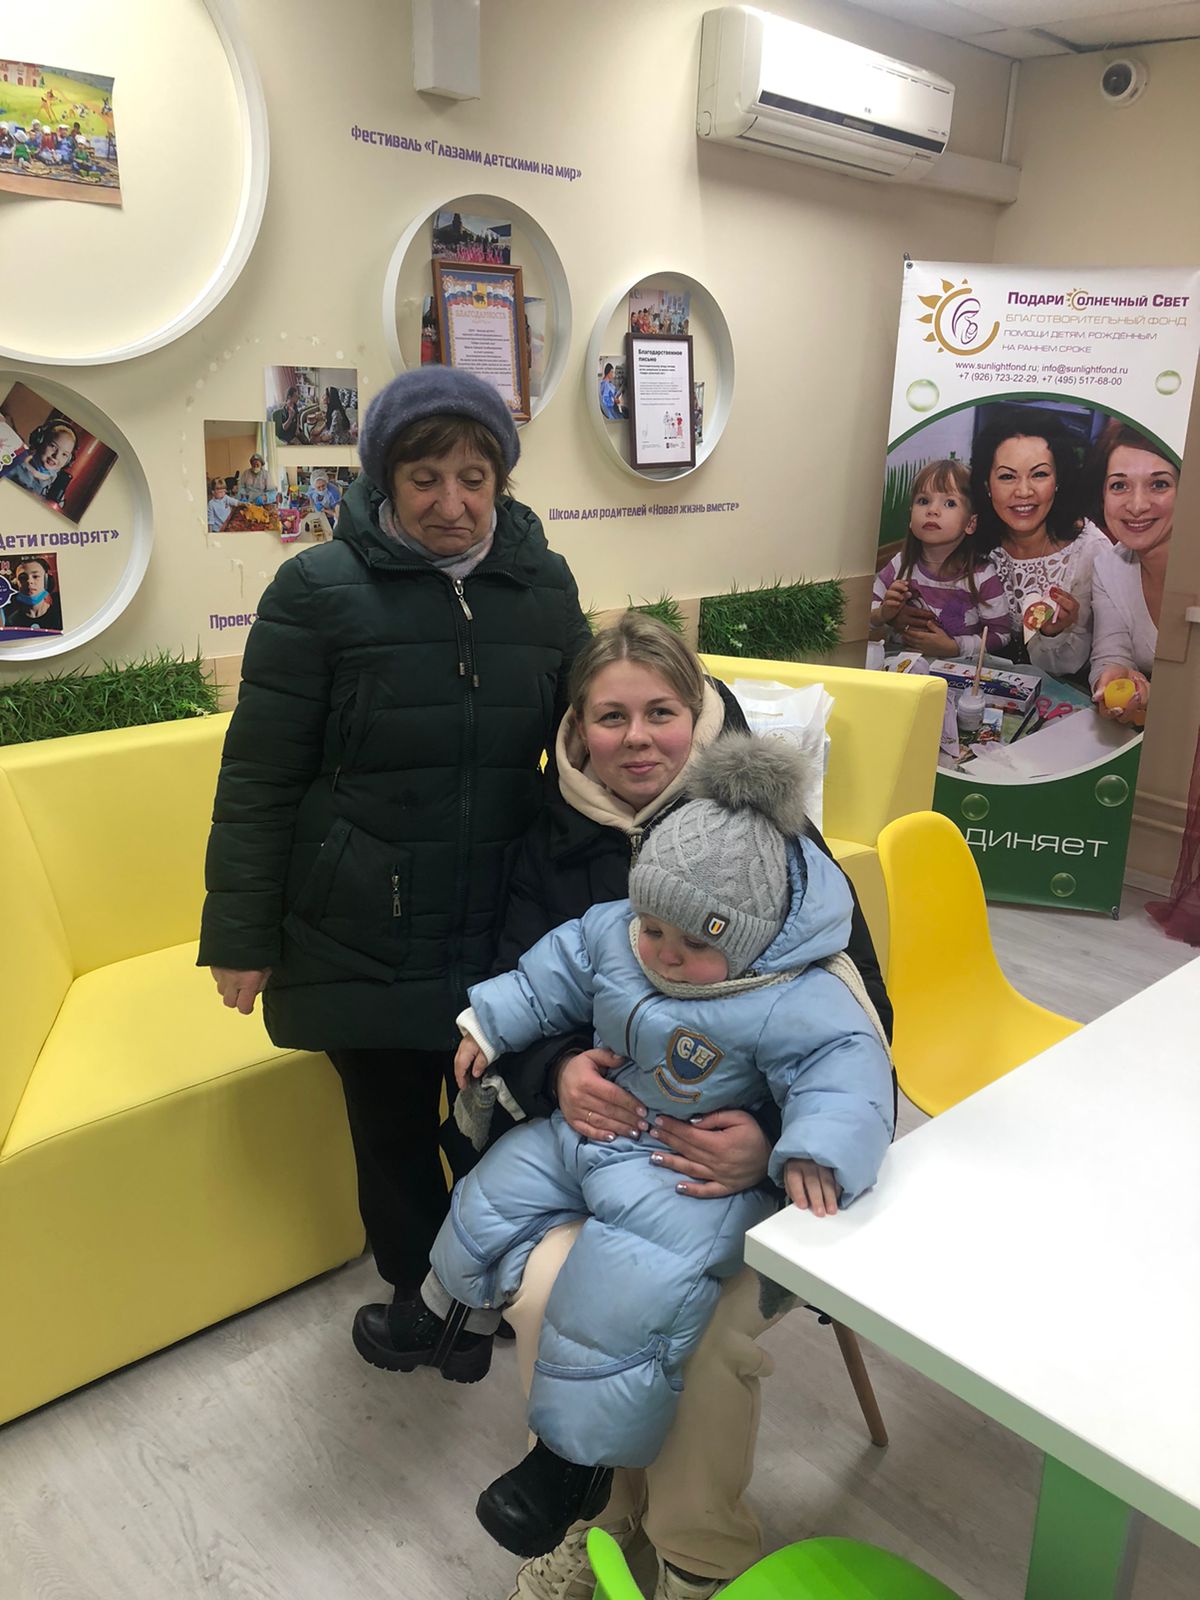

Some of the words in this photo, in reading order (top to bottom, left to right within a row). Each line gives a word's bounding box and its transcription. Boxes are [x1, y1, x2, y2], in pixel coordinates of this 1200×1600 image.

[424, 139, 482, 163] «Глазами
[483, 153, 540, 173] детскими
[540, 163, 554, 176] на
[555, 165, 582, 182] мир»
[1006, 314, 1145, 325] БЛАГОТВОРИТЕЛЬНЫЙ
[1147, 317, 1188, 327] ФОНД
[1003, 329, 1049, 339] ПОМОЩИ
[1002, 344, 1016, 352] НА
[1017, 344, 1058, 353] РАННЕМ
[1059, 345, 1093, 354] СРОКЕ
[1041, 363, 1129, 375] info@sunlightfond.ru
[959, 371, 970, 380] +7
[971, 372, 994, 383] (926)
[995, 373, 1040, 384] 723-22-29,
[1042, 375, 1053, 384] +7
[1054, 375, 1077, 385] (495)
[1078, 375, 1123, 386] 517-68-00
[549, 508, 580, 521] Школа
[581, 508, 598, 521] для
[599, 503, 648, 521] родителей
[648, 503, 679, 516] «Новая
[679, 503, 706, 514] жизнь
[706, 502, 740, 512] вместе»
[41, 529, 120, 547] говорят»
